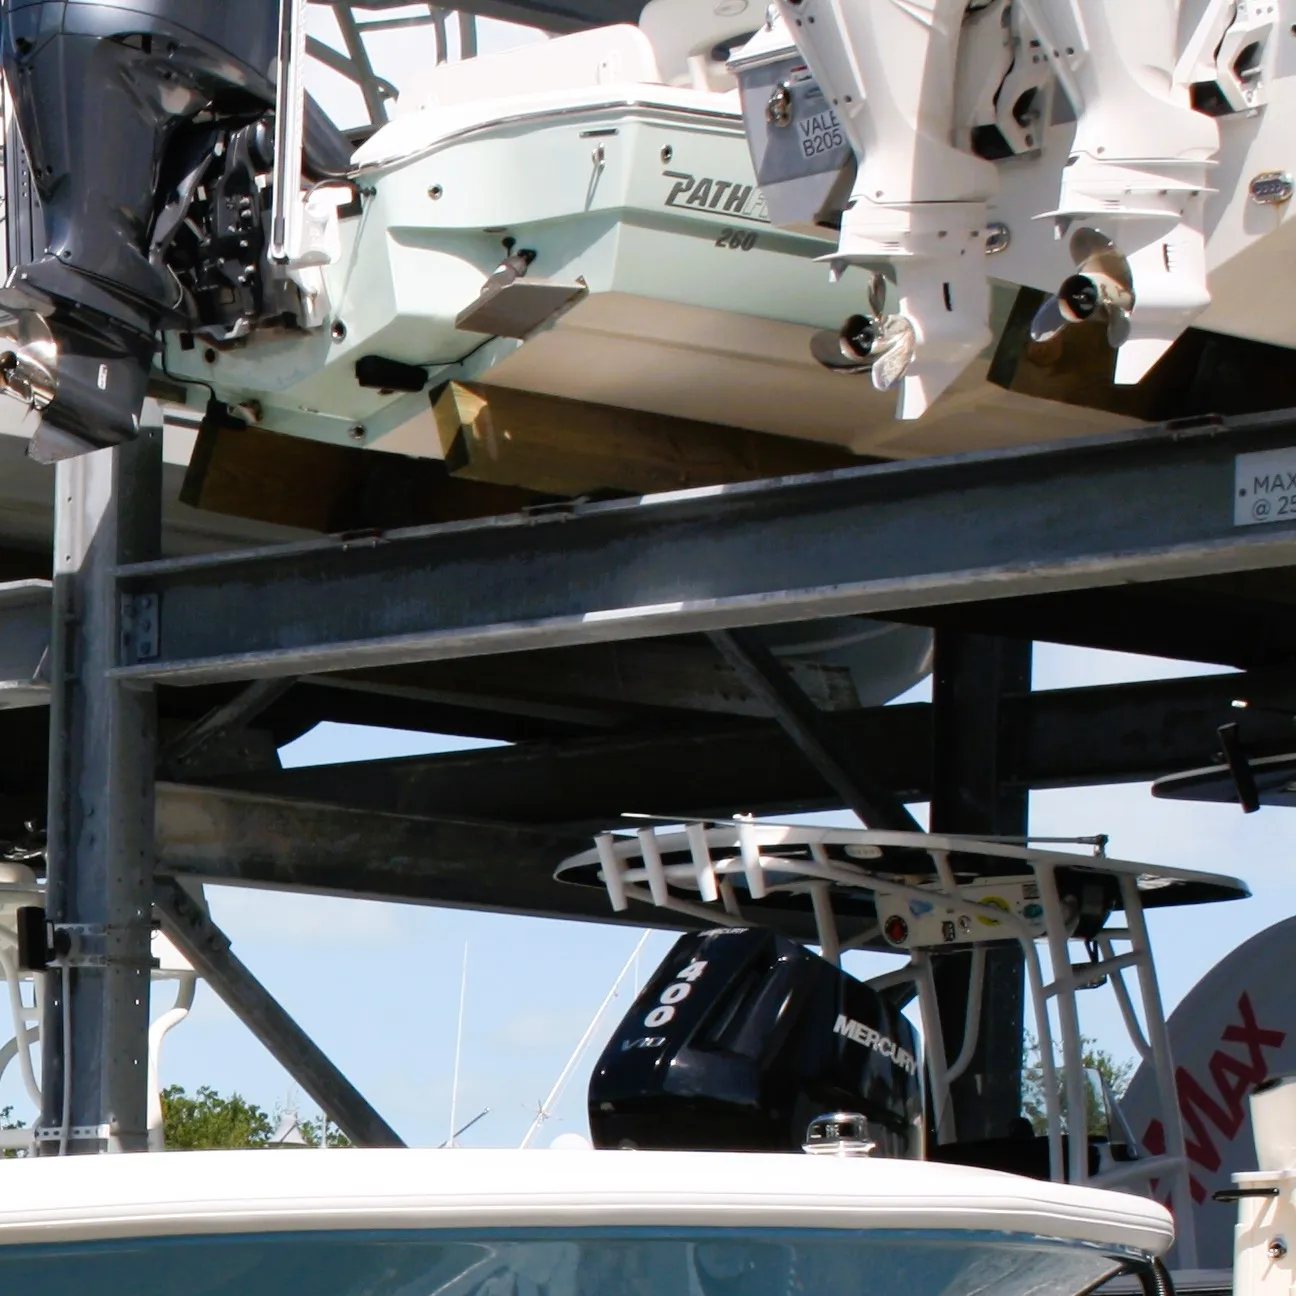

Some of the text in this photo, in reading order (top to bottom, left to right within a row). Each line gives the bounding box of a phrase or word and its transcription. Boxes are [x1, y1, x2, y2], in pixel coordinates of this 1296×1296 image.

[799, 110, 841, 137] VALE
[803, 128, 843, 157] B205
[662, 170, 770, 219] PATHF
[714, 227, 760, 252] 260
[643, 959, 708, 1028] 400
[832, 1013, 918, 1077] MERCURY
[1141, 989, 1287, 1207] MAX
